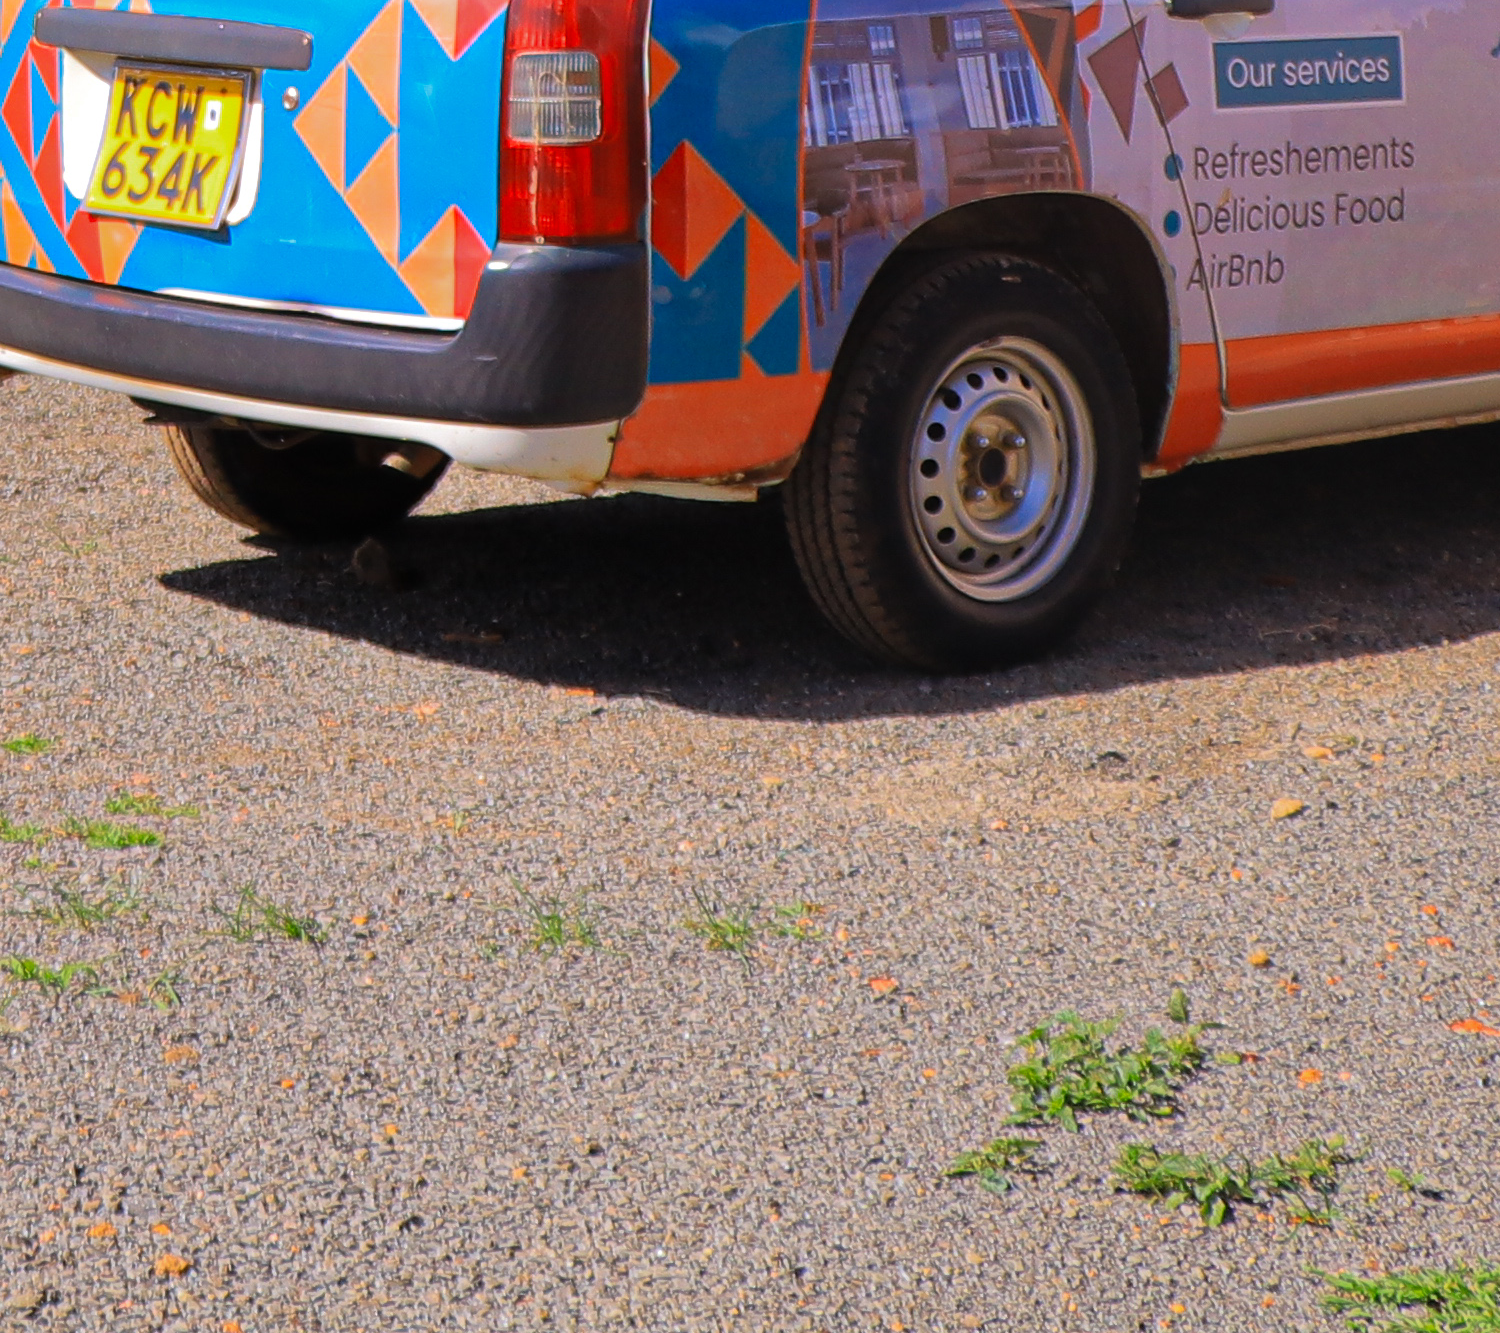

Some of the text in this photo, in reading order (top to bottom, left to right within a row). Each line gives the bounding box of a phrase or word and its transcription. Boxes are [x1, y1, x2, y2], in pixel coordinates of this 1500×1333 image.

[1227, 52, 1390, 88] Our services
[115, 76, 206, 146] KCW
[101, 141, 220, 215] 634K
[1193, 137, 1415, 181] Refreshements
[1193, 186, 1405, 236] Delicious Food
[1186, 250, 1285, 292] AirBnb
